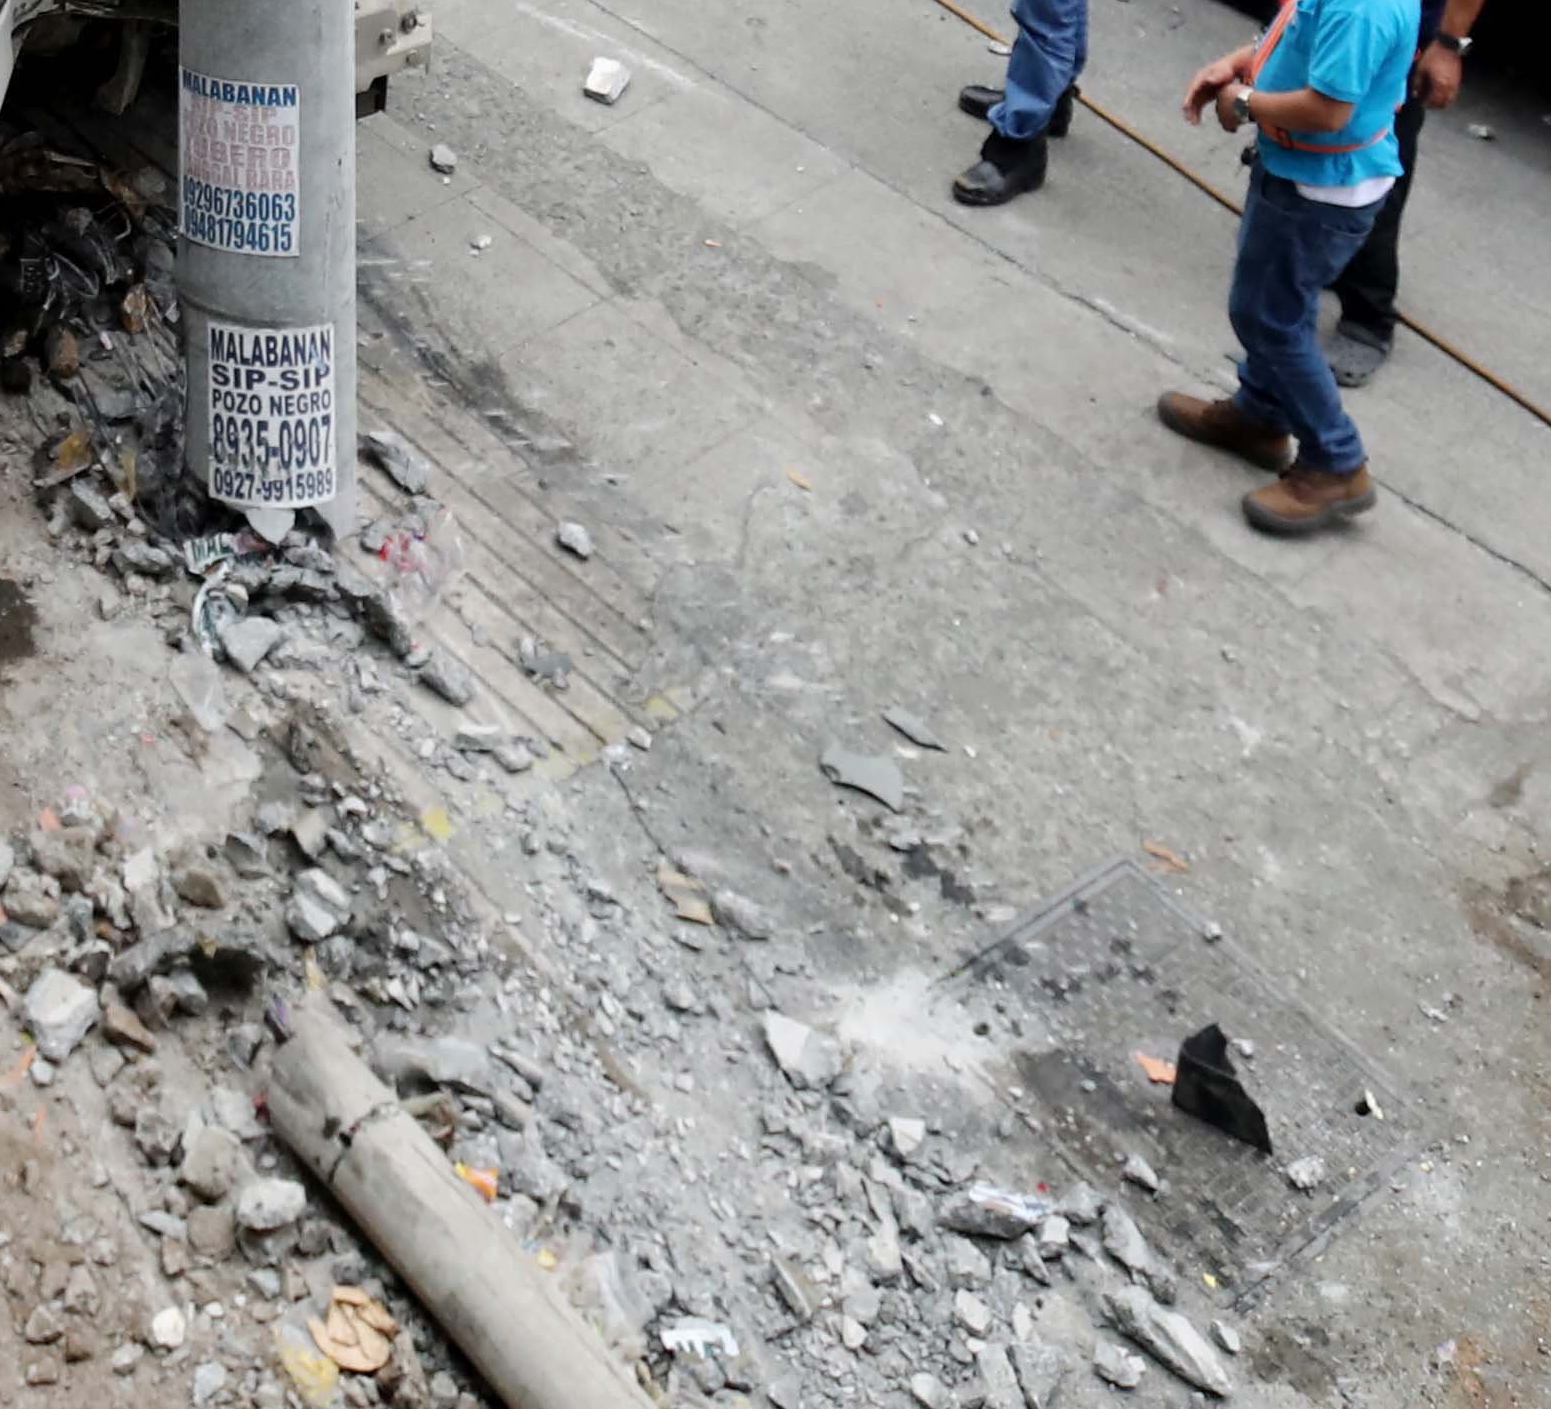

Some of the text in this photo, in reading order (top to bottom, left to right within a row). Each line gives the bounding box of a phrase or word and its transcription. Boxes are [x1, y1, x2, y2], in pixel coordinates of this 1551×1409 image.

[183, 69, 297, 107] MALABANAN
[210, 327, 332, 369] MALABANAN
[211, 363, 330, 392] SIP-SIP
[212, 388, 332, 418] POZO NEGRO
[212, 412, 332, 471] 8935-0907
[213, 465, 334, 503] 0927-9915989
